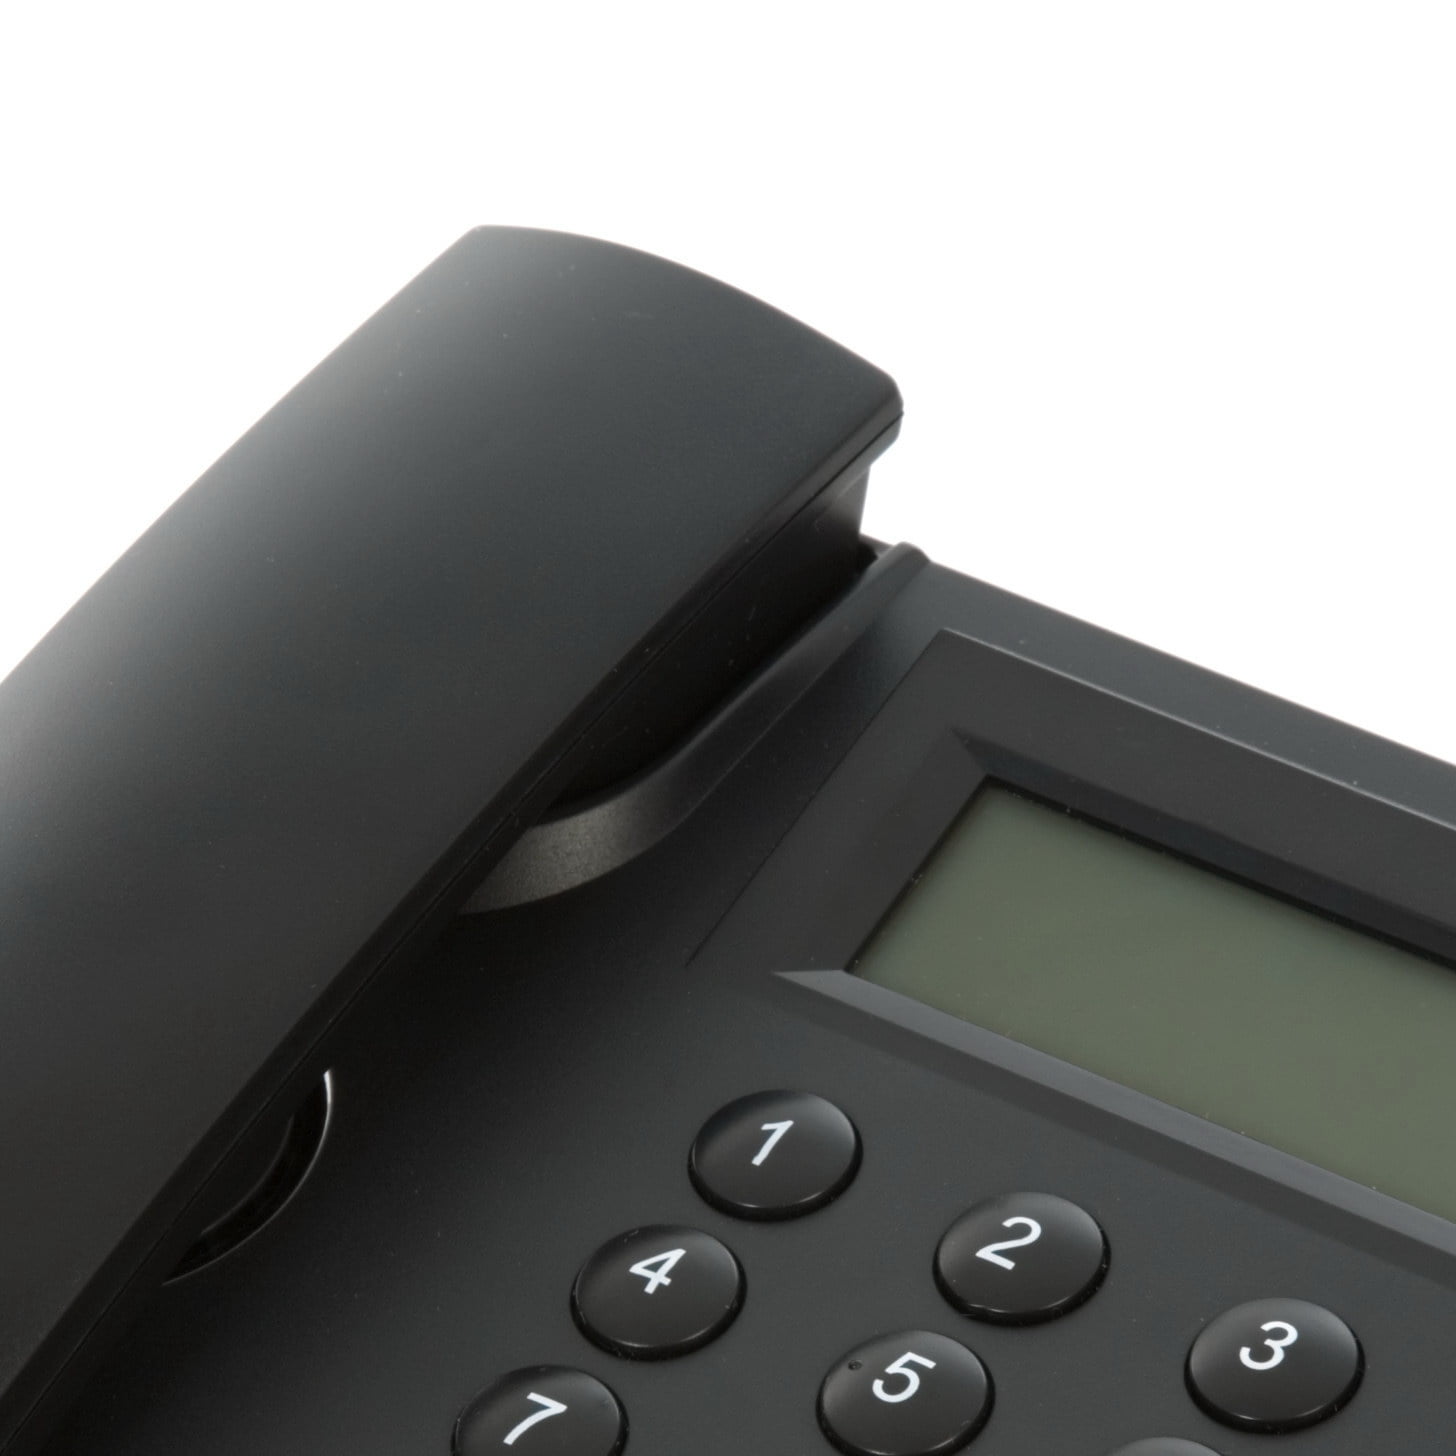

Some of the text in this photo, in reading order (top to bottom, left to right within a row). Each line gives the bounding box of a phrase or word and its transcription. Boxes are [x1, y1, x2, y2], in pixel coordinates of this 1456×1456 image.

[750, 1118, 796, 1168] 1
[974, 1214, 1043, 1272] 2
[627, 1246, 688, 1296] 4
[1237, 1319, 1300, 1372] 3
[870, 1350, 938, 1405] 5
[501, 1390, 569, 1447] 7
